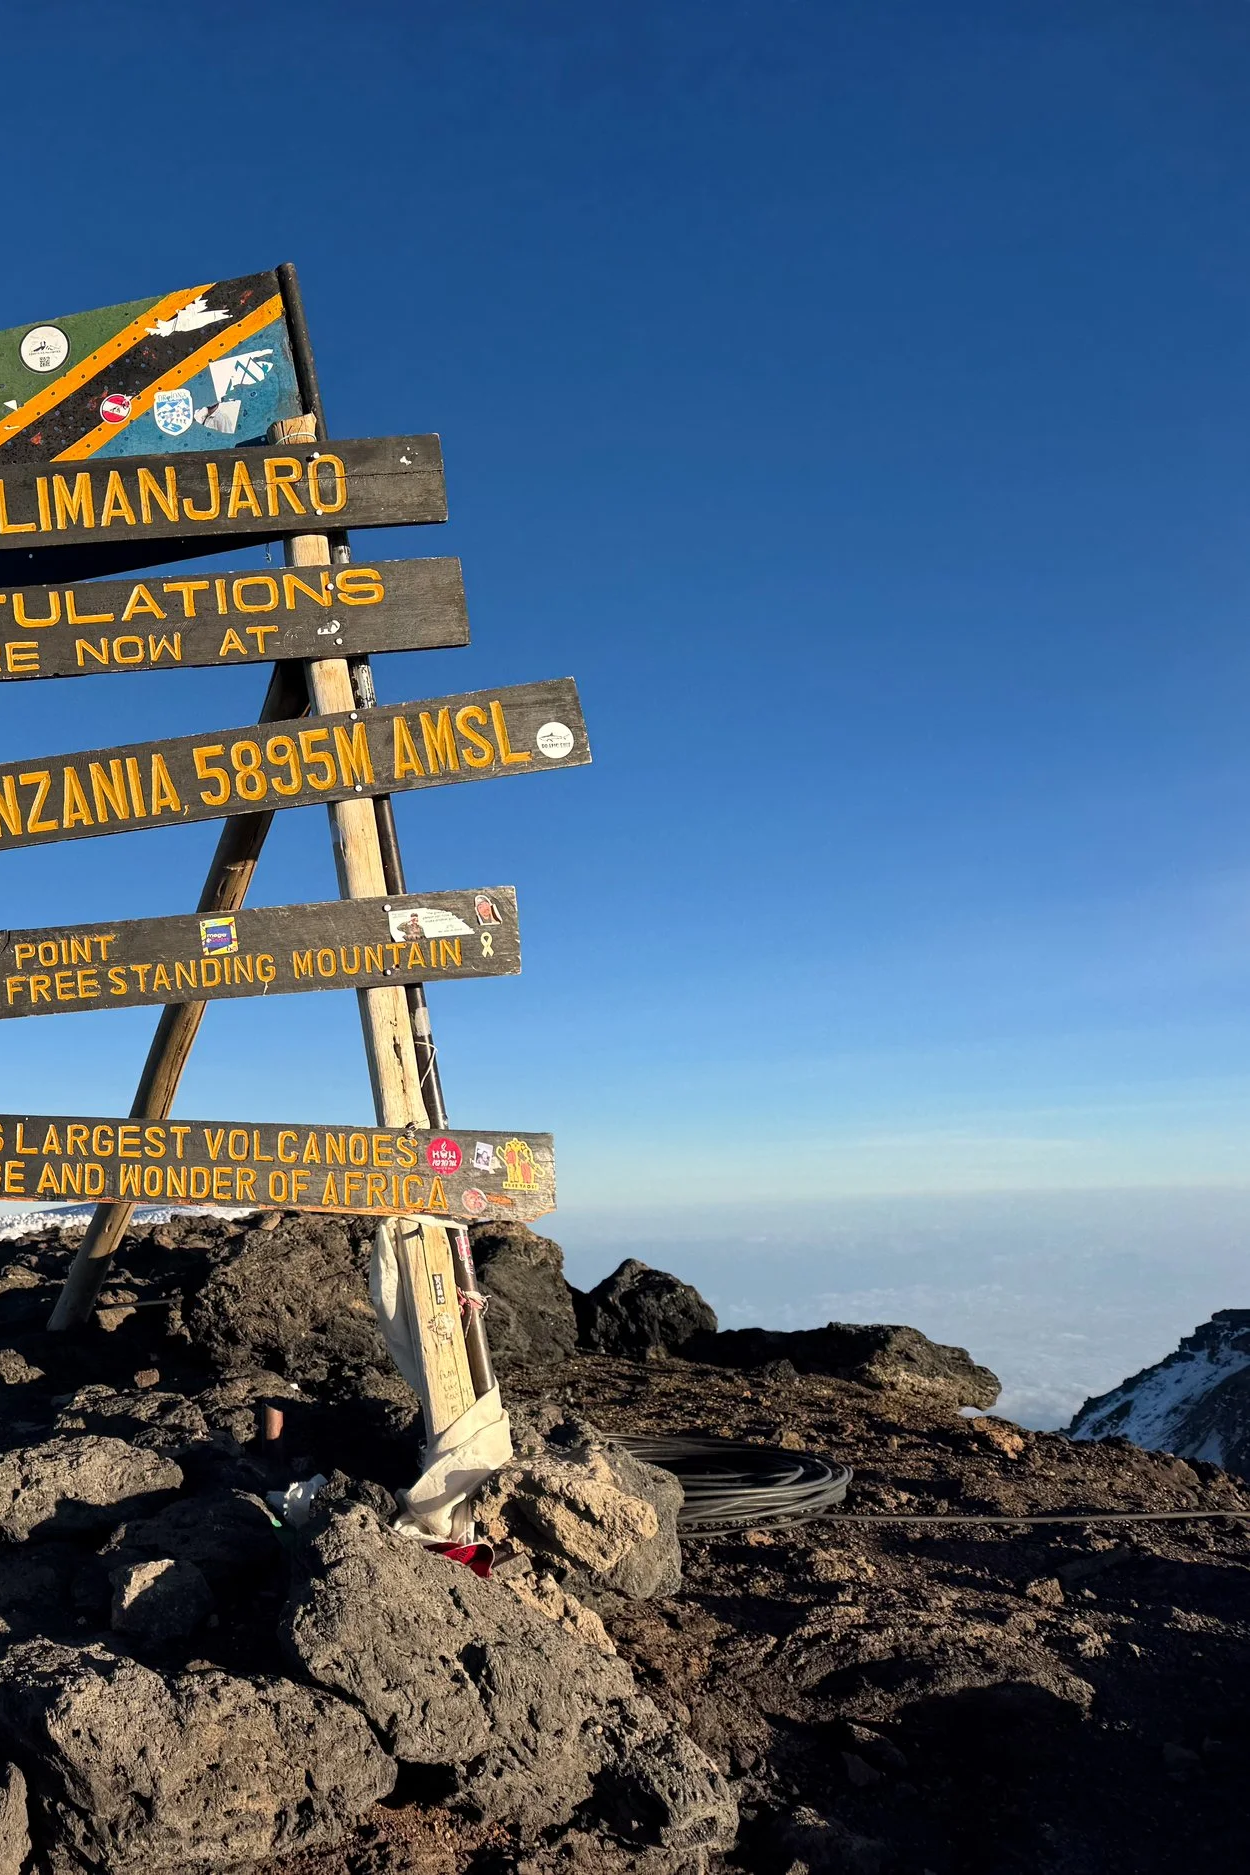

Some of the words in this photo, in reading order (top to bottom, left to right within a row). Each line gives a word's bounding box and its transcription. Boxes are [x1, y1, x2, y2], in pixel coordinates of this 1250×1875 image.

[75, 633, 182, 667] NOW
[219, 625, 279, 658] AT
[192, 722, 376, 807] 5895M
[394, 701, 534, 781] AMSL
[15, 934, 116, 969] POINT
[292, 937, 464, 980] MOUNTAIN
[15, 1123, 191, 1159] LARGEST
[203, 1127, 419, 1169] VOLCANOES
[35, 1162, 105, 1196] AND
[118, 1163, 258, 1202] WONDER
[268, 1168, 312, 1204] OF
[322, 1170, 449, 1210] AFRICA
